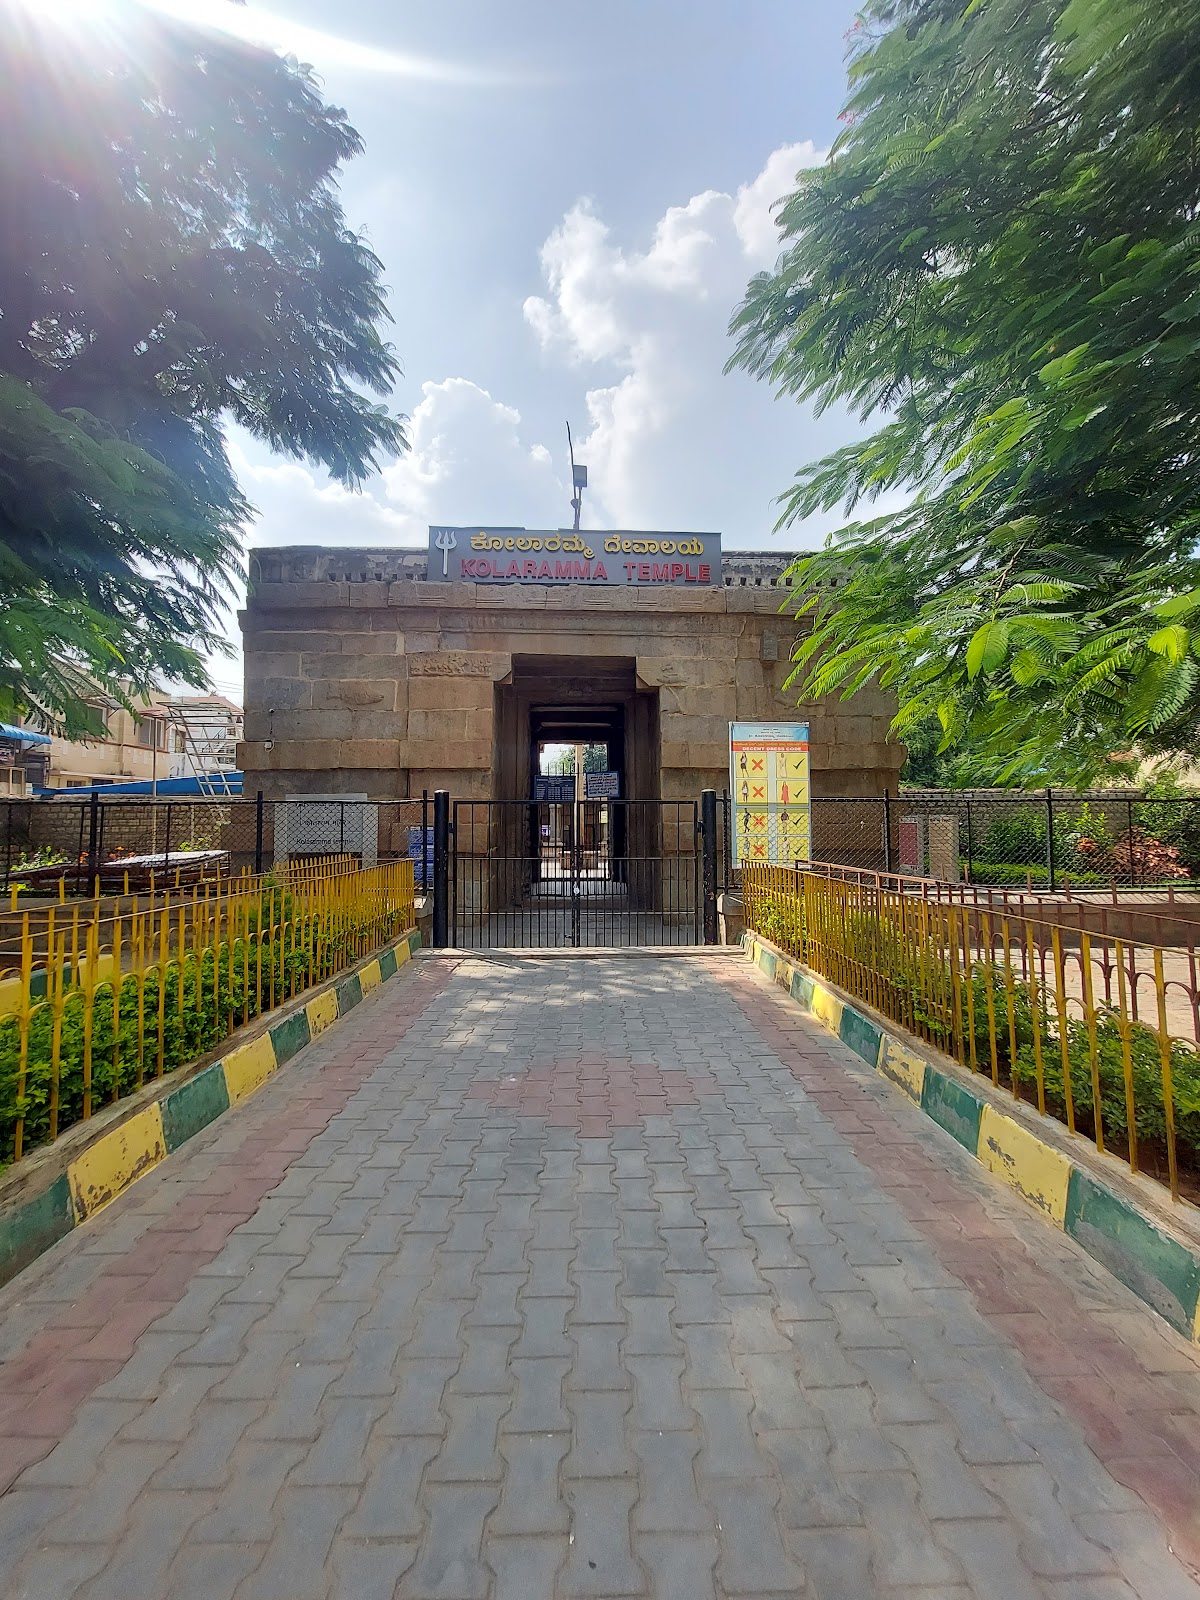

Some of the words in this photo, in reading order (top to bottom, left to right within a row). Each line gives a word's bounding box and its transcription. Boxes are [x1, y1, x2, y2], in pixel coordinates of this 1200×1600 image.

[470, 531, 595, 559] ಕೋಲಾರಮ್ಮ
[604, 534, 704, 555] ದೇವಾಲಯ
[460, 558, 608, 580] KOLARAMMA
[623, 562, 711, 582] TEMPLE
